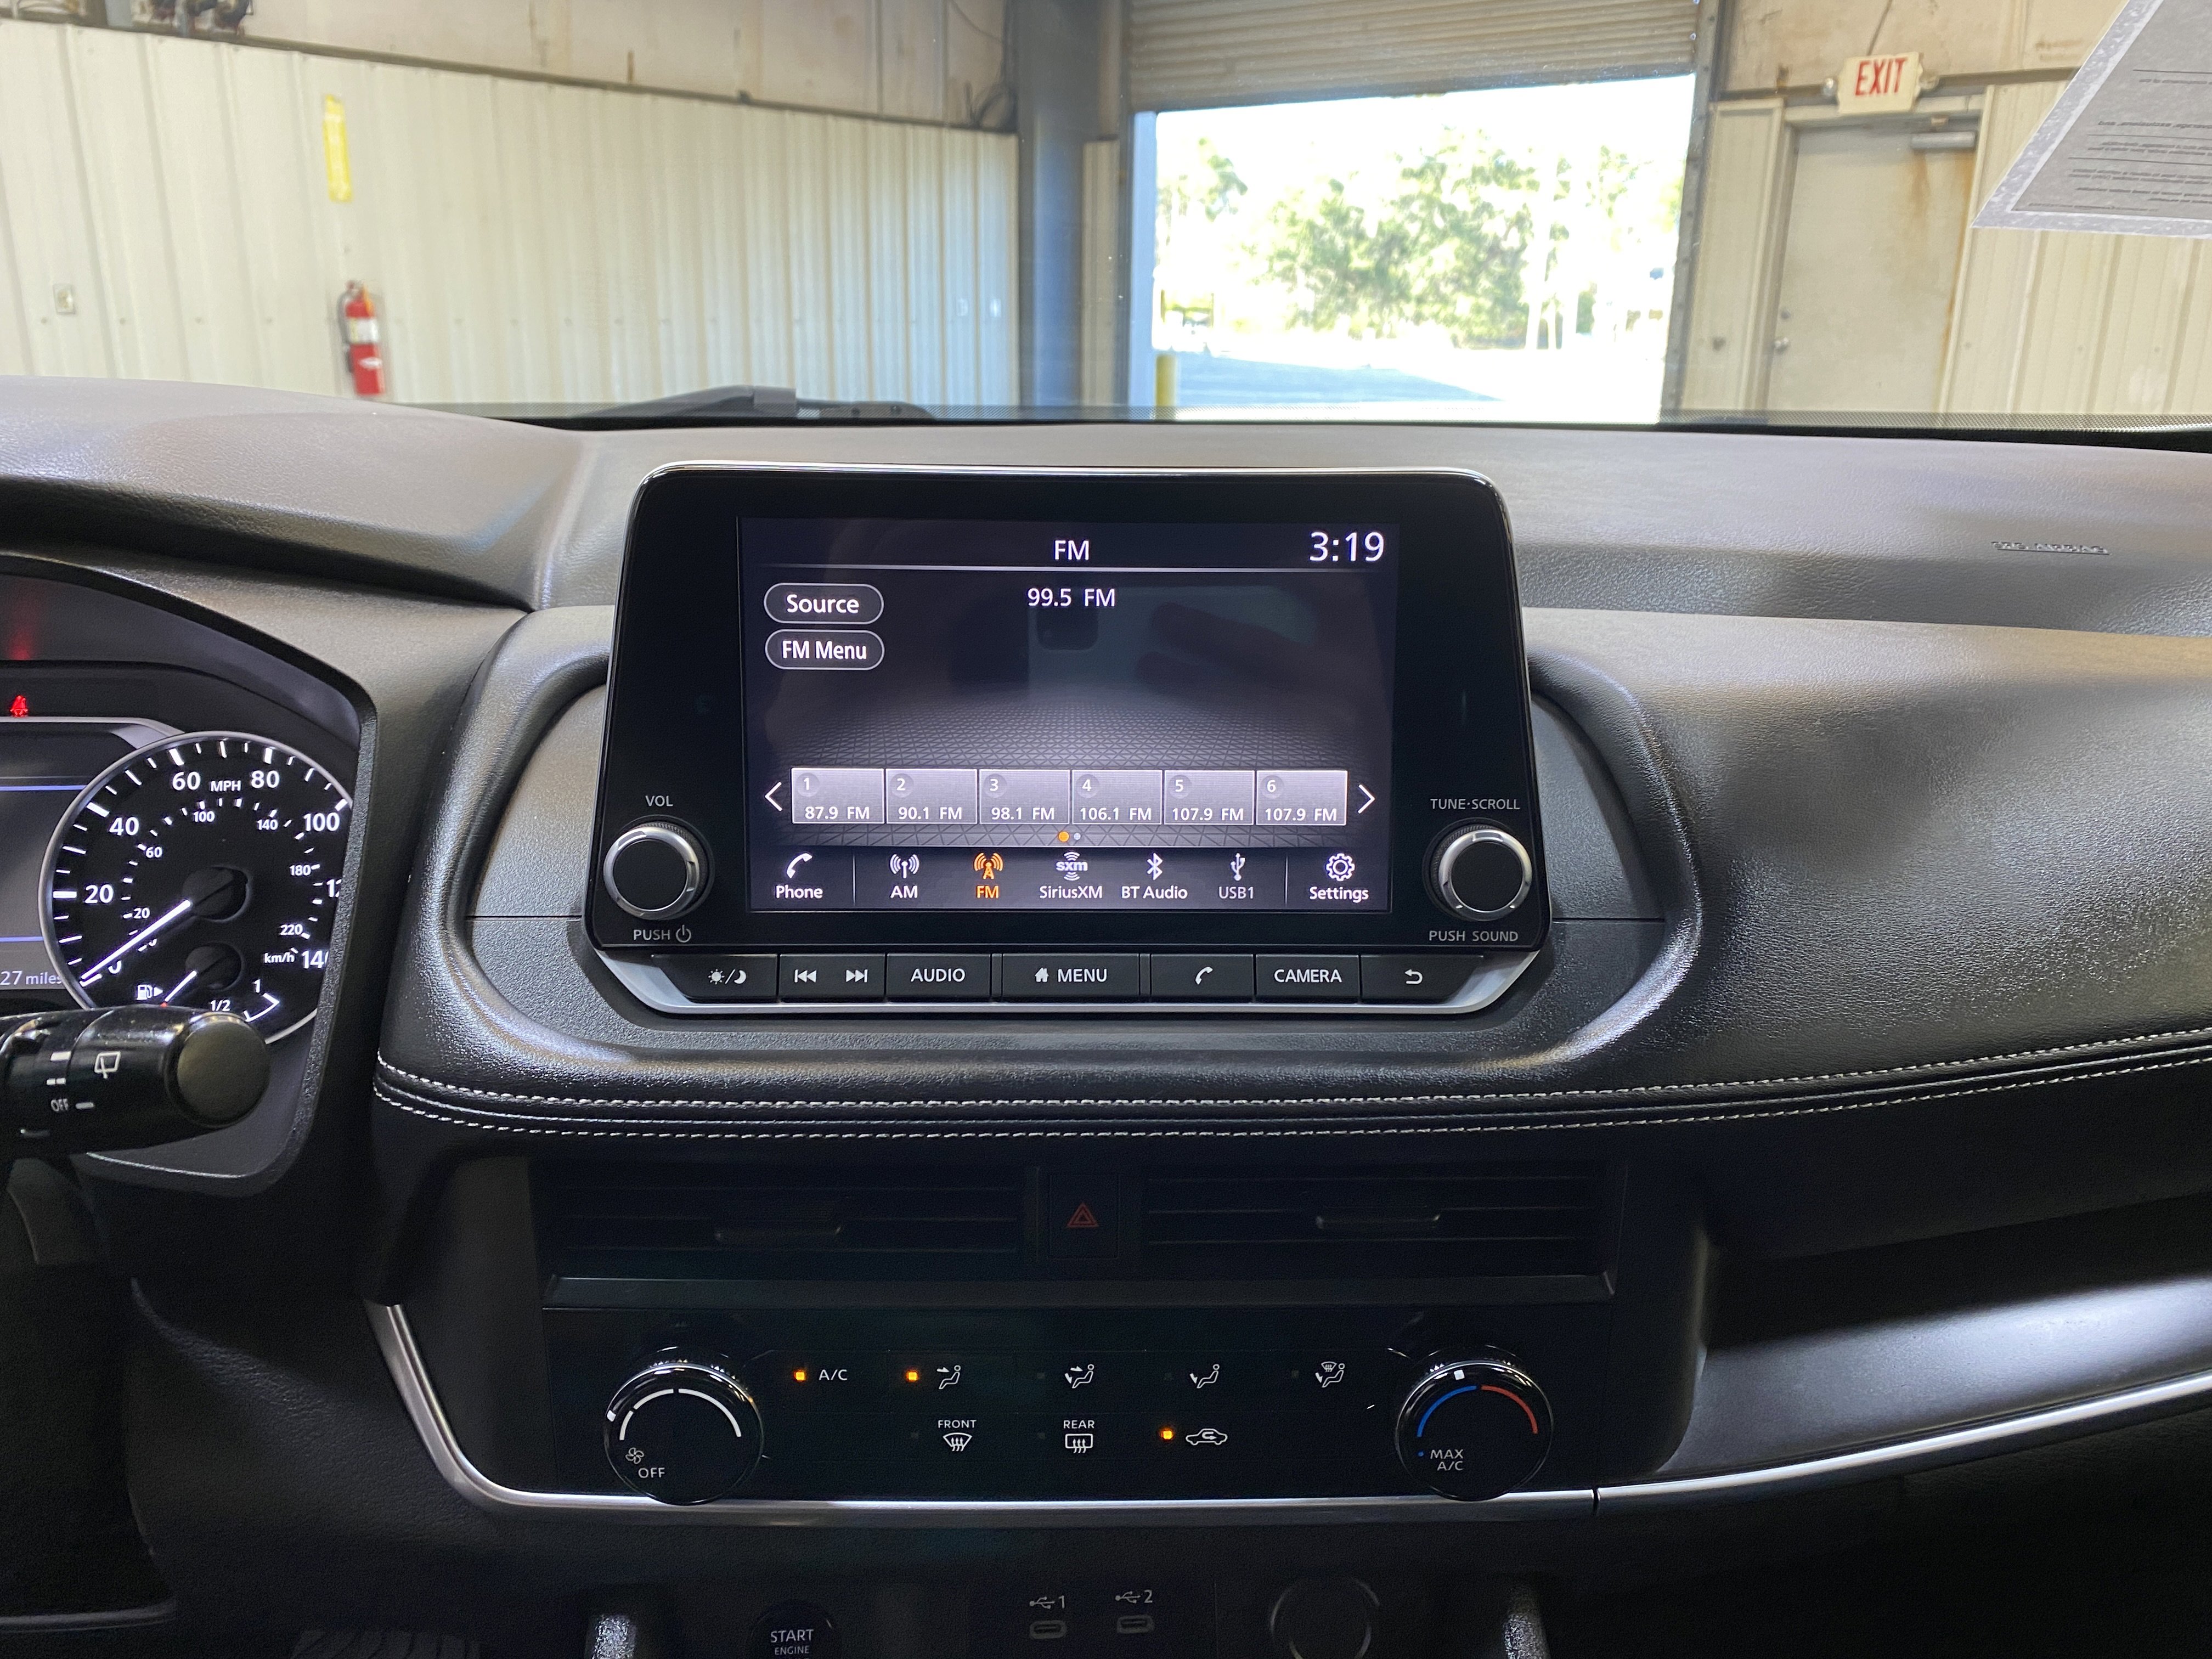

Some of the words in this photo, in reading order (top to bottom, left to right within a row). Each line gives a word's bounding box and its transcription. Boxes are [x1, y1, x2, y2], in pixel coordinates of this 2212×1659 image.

[1855, 58, 1906, 97] EXIT
[1054, 540, 1089, 560] FM
[1310, 532, 1384, 562] 3:19
[786, 594, 859, 614] Source
[1028, 588, 1071, 607] 99.5
[1084, 588, 1115, 607] FM
[782, 640, 810, 659] FM
[815, 641, 867, 660] Menu
[172, 771, 201, 791] 60
[251, 770, 280, 788] 80
[804, 778, 810, 790] 1
[896, 778, 905, 791] 2
[990, 779, 998, 791] 3
[210, 780, 241, 792] MPH
[1082, 780, 1091, 792] 4
[1175, 780, 1183, 792] 5
[1267, 780, 1276, 792] 6
[645, 795, 674, 807] VOL
[192, 810, 216, 822] 100
[805, 807, 838, 820] 87.9
[847, 808, 870, 820] FM
[898, 807, 929, 820] 90.1
[940, 808, 962, 820] FM
[991, 808, 1022, 820] 98.1
[1032, 808, 1054, 820] FM
[1080, 808, 1119, 820] 106.1
[1129, 809, 1152, 821] FM
[1172, 808, 1213, 821] 107.9
[1222, 809, 1244, 821] FM
[1265, 809, 1306, 821] 107.9
[1314, 809, 1337, 821] FM
[109, 816, 139, 836] 40
[257, 819, 279, 831] 140
[303, 812, 340, 832] 100
[145, 846, 163, 859] 60
[290, 865, 311, 877] 180
[84, 884, 114, 904] 20
[776, 884, 823, 899] Phone
[890, 885, 918, 899] AM
[977, 886, 999, 899] FM
[1040, 885, 1102, 899] SiriusXM
[1121, 885, 1141, 899] BT
[1142, 885, 1188, 899] Audio
[1218, 886, 1254, 899] USB1
[1309, 886, 1369, 904] Settings
[133, 907, 150, 919] 20
[279, 923, 303, 936] 220
[634, 929, 670, 940] PUSH
[1429, 931, 1465, 941] PUSH
[1472, 932, 1519, 942] SOUND
[264, 952, 295, 963] km/h
[911, 968, 966, 982] AUDIO
[1058, 968, 1107, 983] MENU
[1274, 969, 1342, 983] CAMERA
[210, 999, 231, 1012] 1/2
[819, 1369, 848, 1381] A/C
[938, 1419, 977, 1429] FRONT
[1063, 1420, 1095, 1429] REAR
[1430, 1449, 1464, 1459] MAX
[1437, 1460, 1463, 1471] A/C
[638, 1467, 665, 1479] OFF
[771, 1628, 814, 1643] START
[775, 1645, 809, 1655] ENGINE
